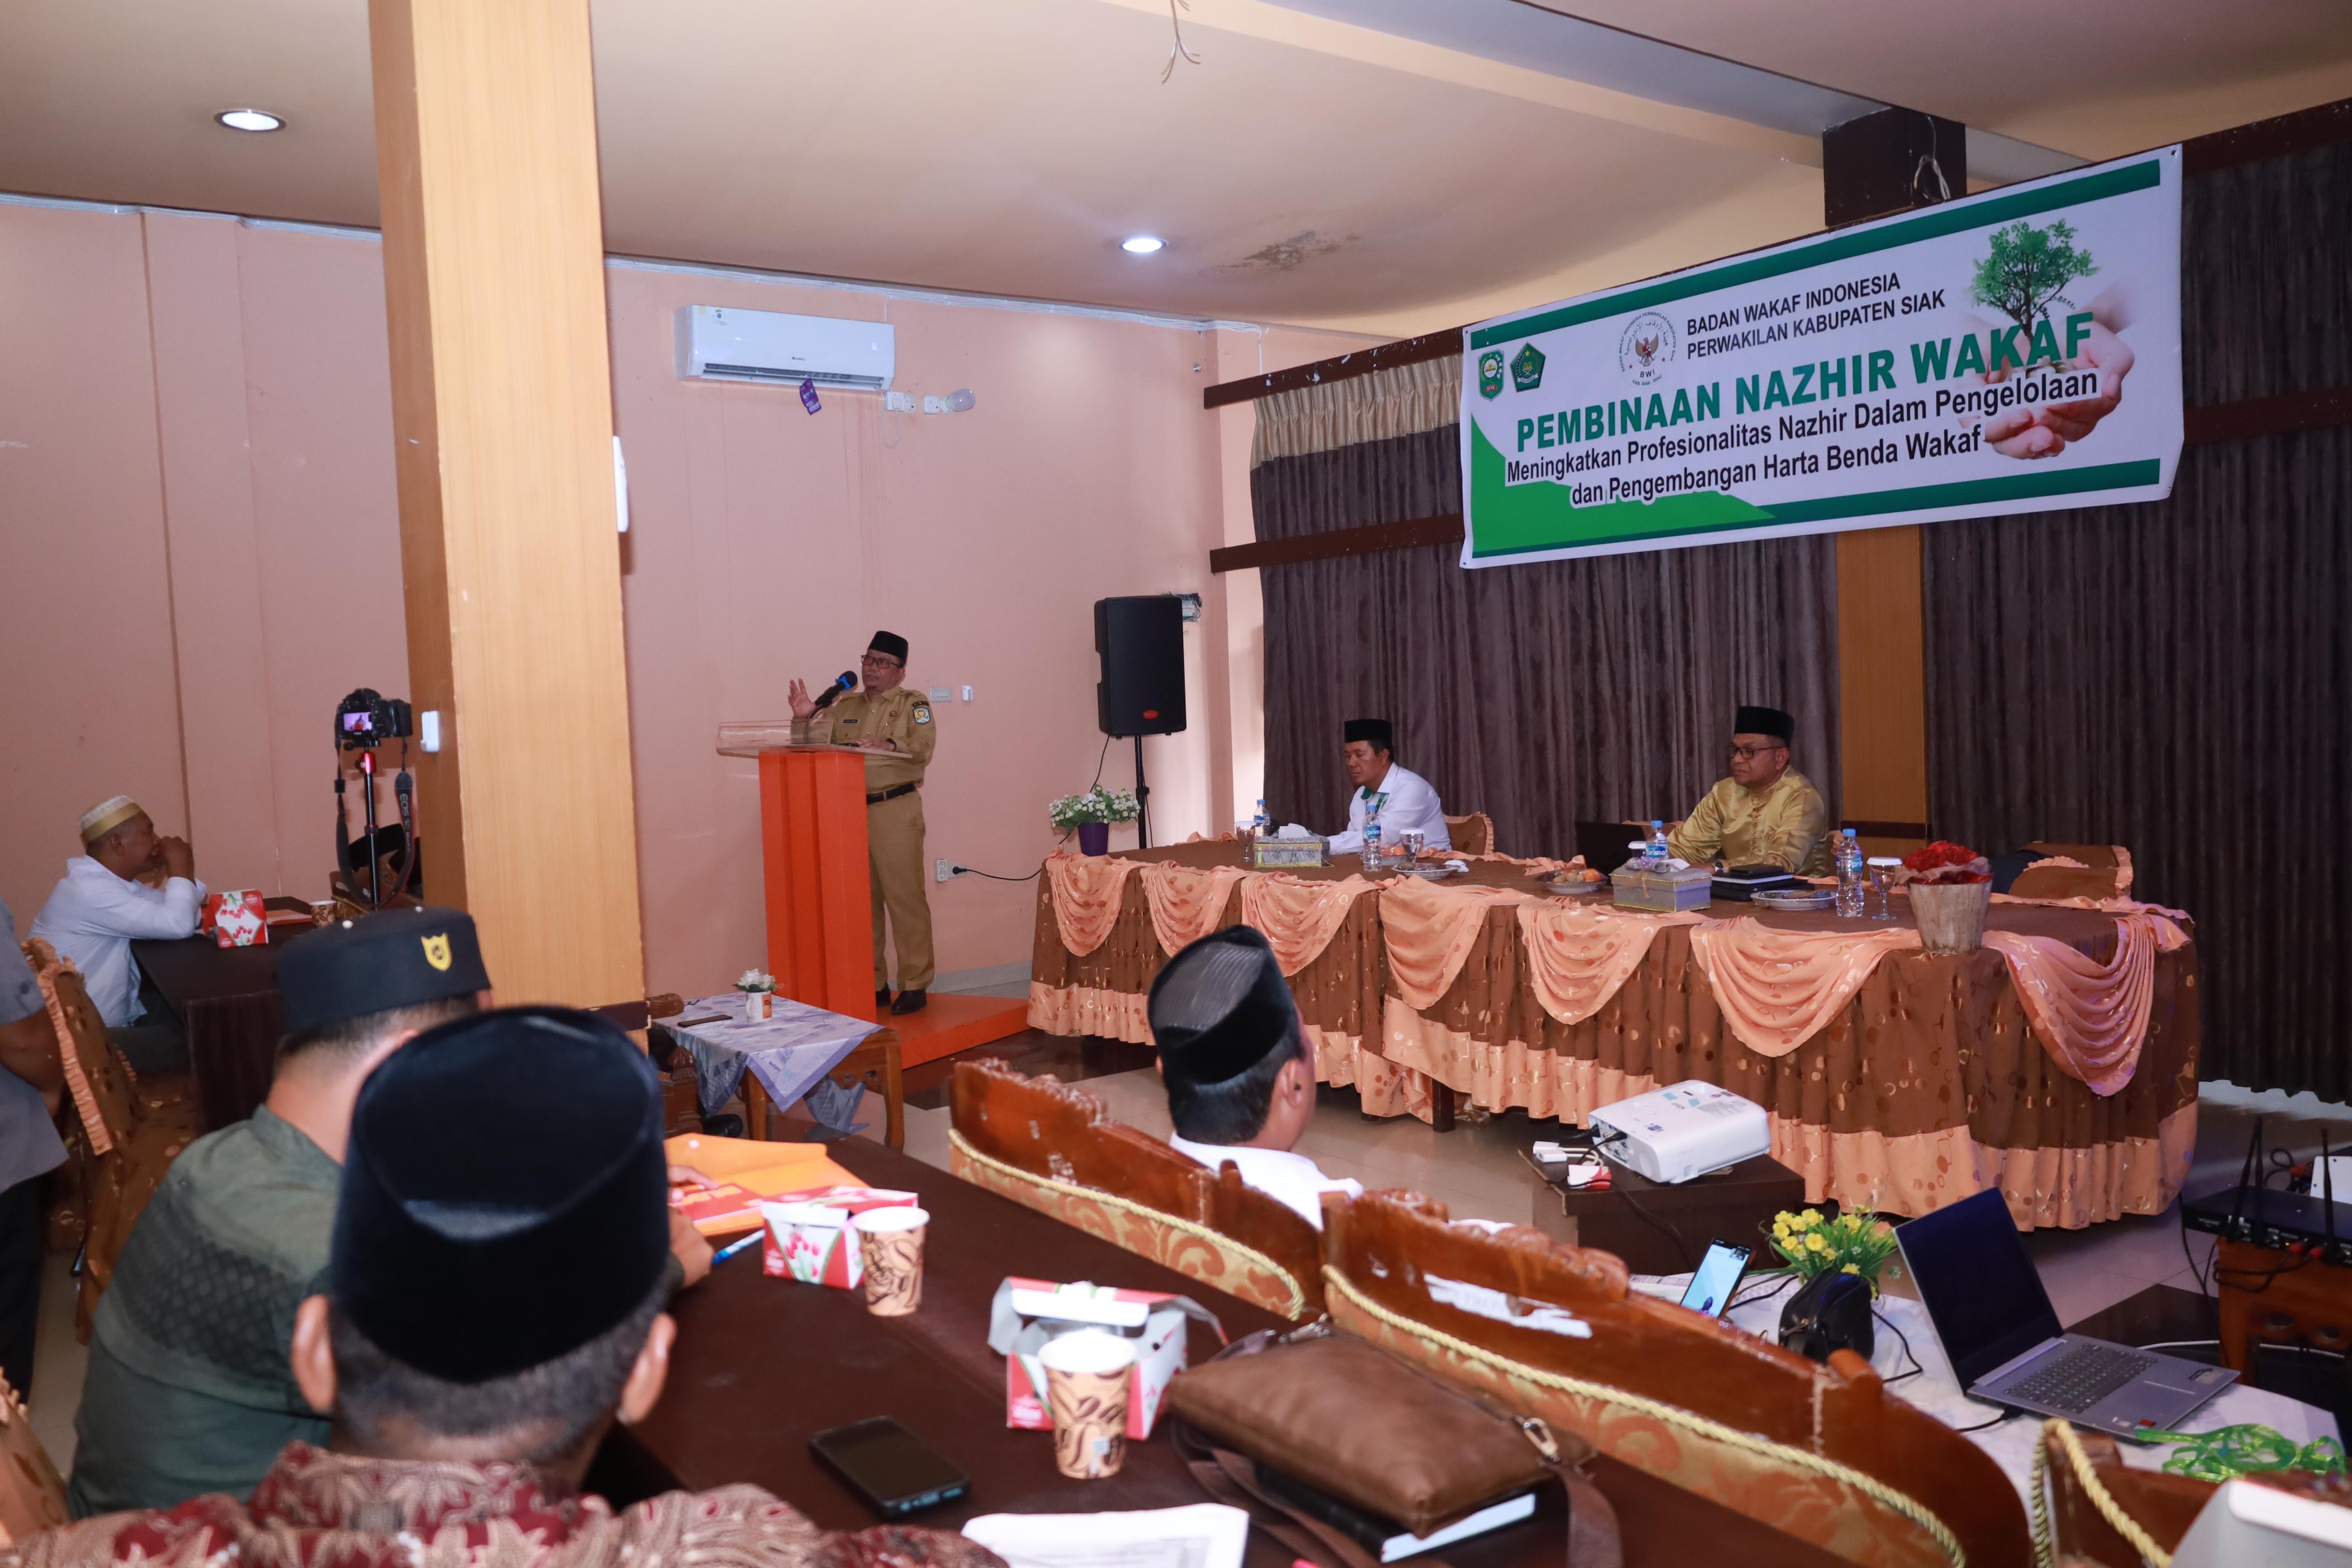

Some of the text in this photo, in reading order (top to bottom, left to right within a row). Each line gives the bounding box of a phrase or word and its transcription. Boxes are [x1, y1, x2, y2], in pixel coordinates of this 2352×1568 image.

[1642, 311, 1667, 321] PERWAKILAN
[1667, 319, 1676, 348] KABUPATEN
[1688, 272, 1900, 335] BADAN WAKAF INDONESIA
[1688, 289, 1945, 359] PERWAKILAN KABUPATEN SIAK
[1517, 312, 2093, 452] PEMBINAAN NAZHIR WAKAF
[1640, 369, 1655, 378] BWI
[1508, 372, 2097, 483] Meningkatkan Profesionalitas Nazhir Dalam Pengelolaan
[1572, 424, 1981, 505] dan Pengembangan Harta Benda Wakaf
[400, 793, 409, 817] EOS
